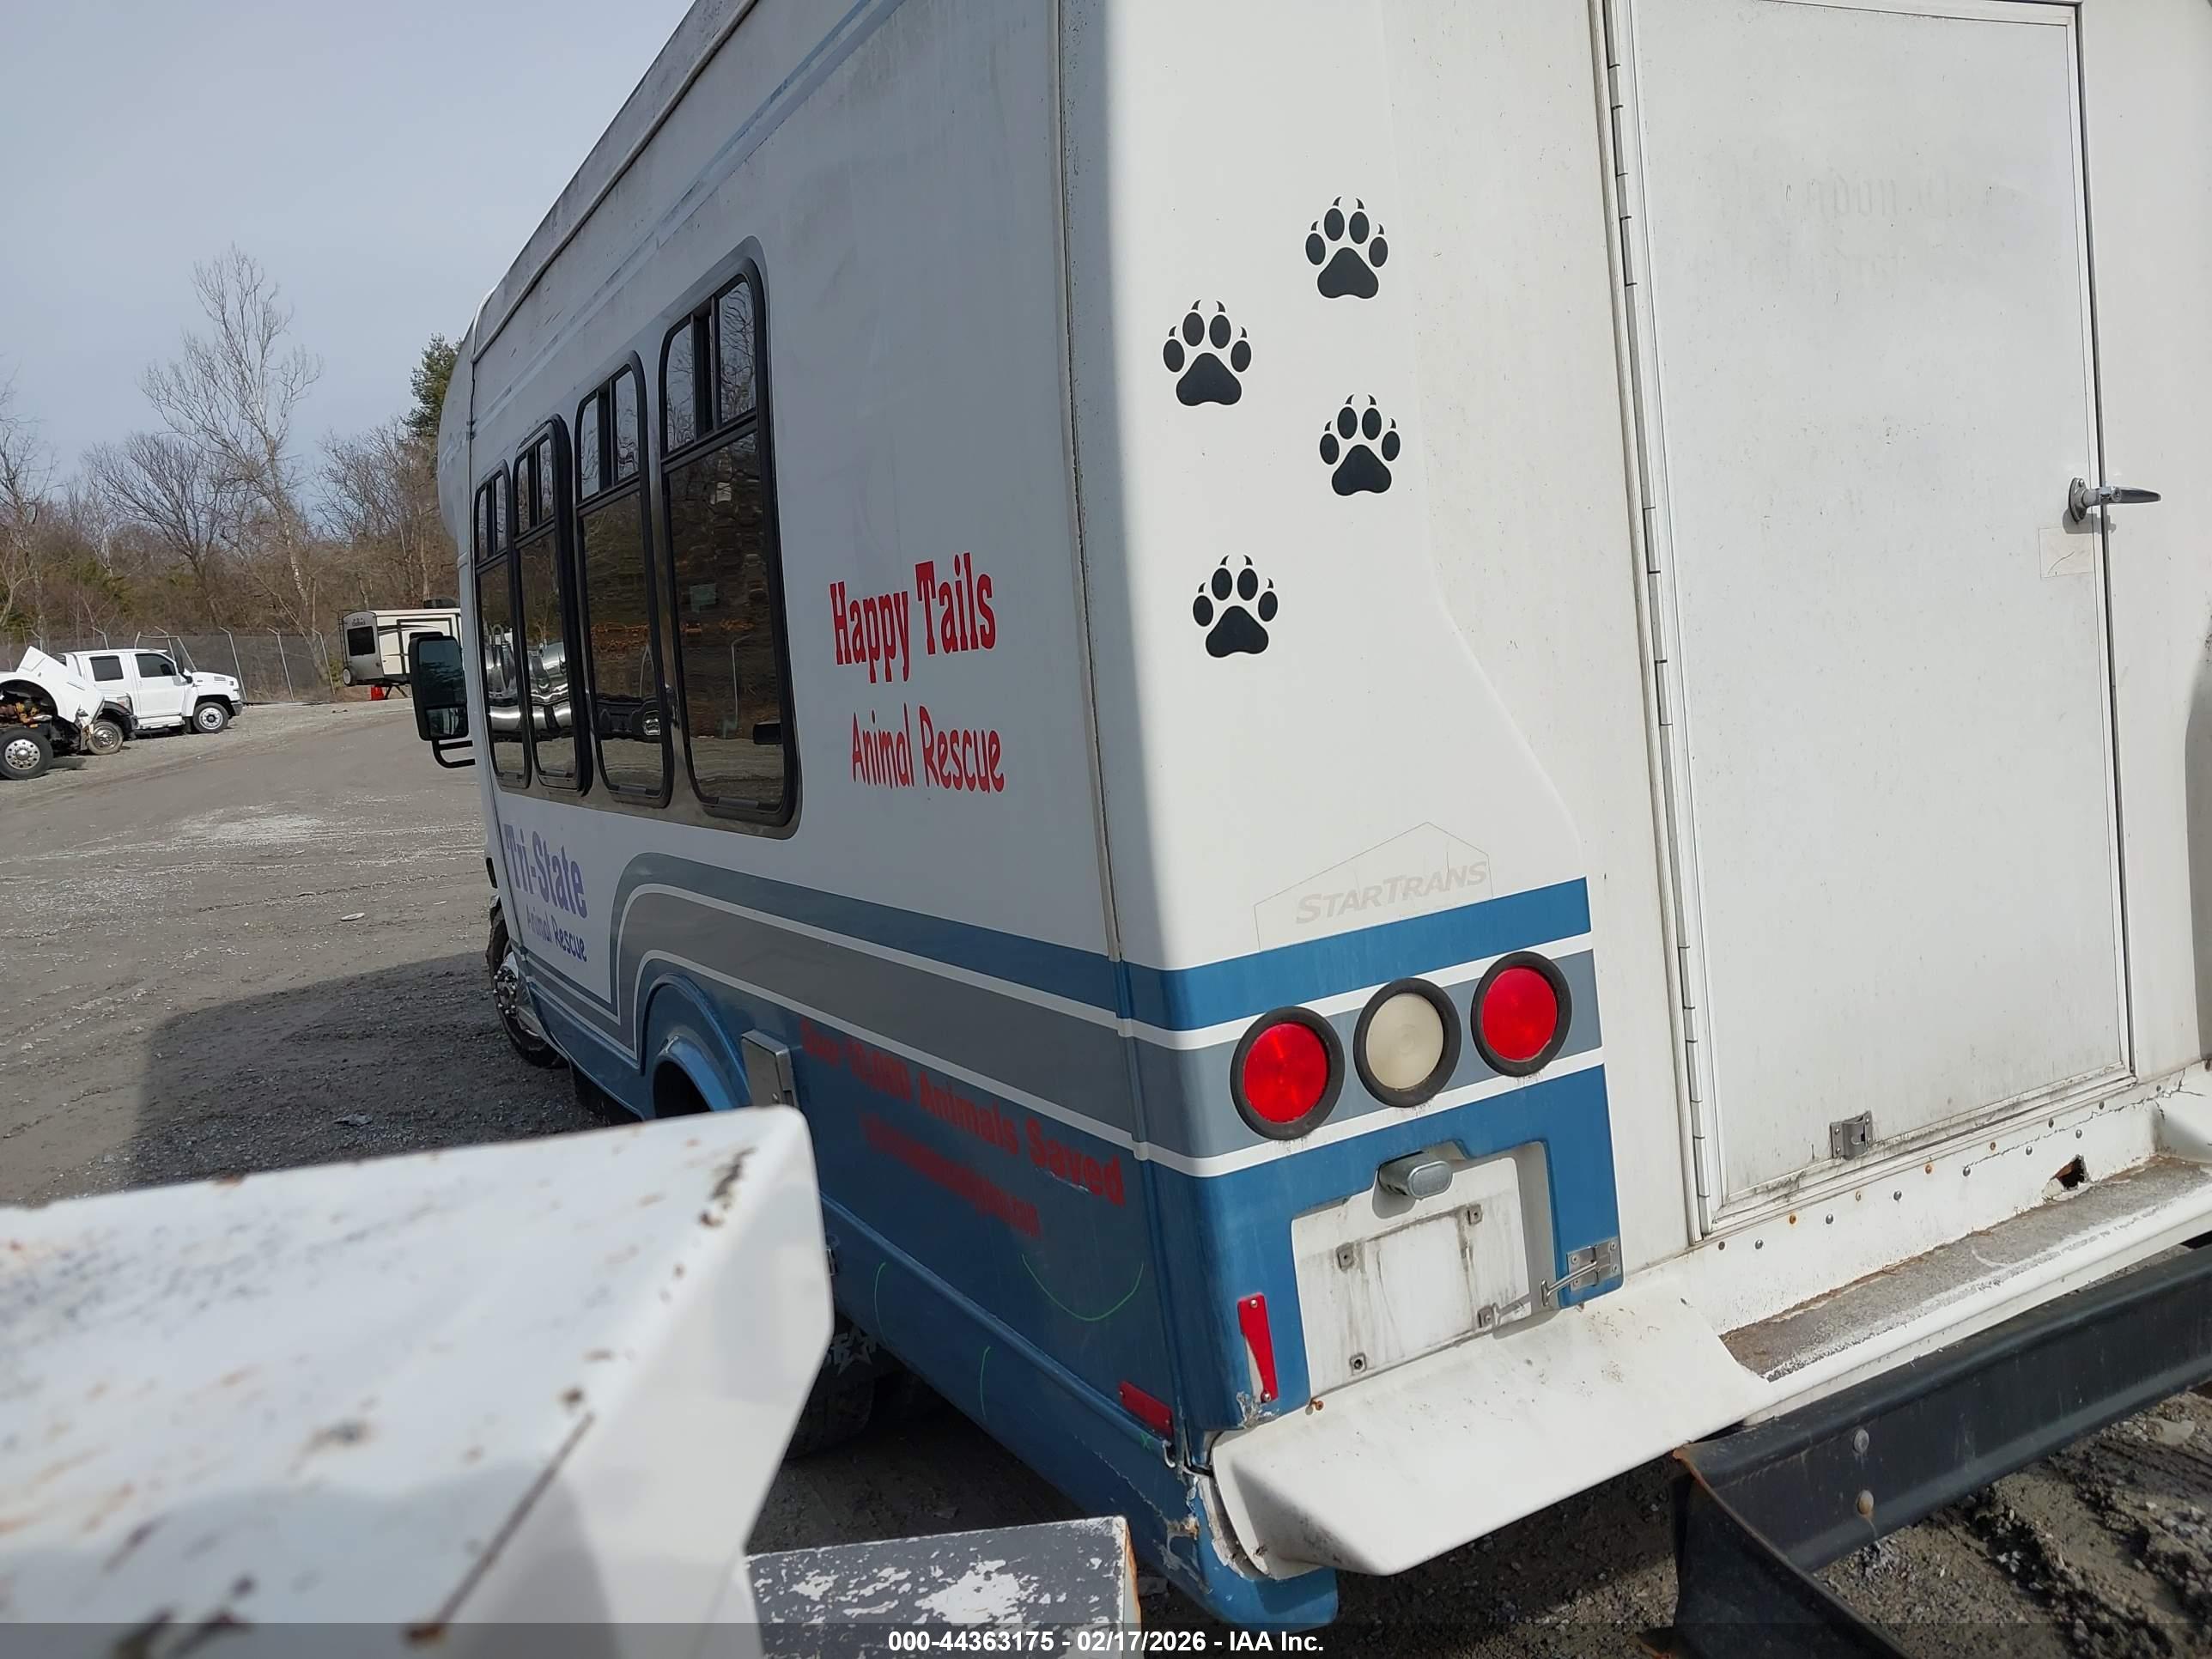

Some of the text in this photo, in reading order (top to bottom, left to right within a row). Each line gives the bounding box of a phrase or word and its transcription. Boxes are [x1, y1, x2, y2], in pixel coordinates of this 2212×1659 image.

[830, 552, 996, 684] Happy Tails
[852, 702, 1005, 793] Animal Rescue
[503, 823, 588, 919] Tri-State
[526, 904, 587, 962] Animal Rescue
[919, 1070, 1019, 1156] Animals
[1026, 1115, 1126, 1206] Saved
